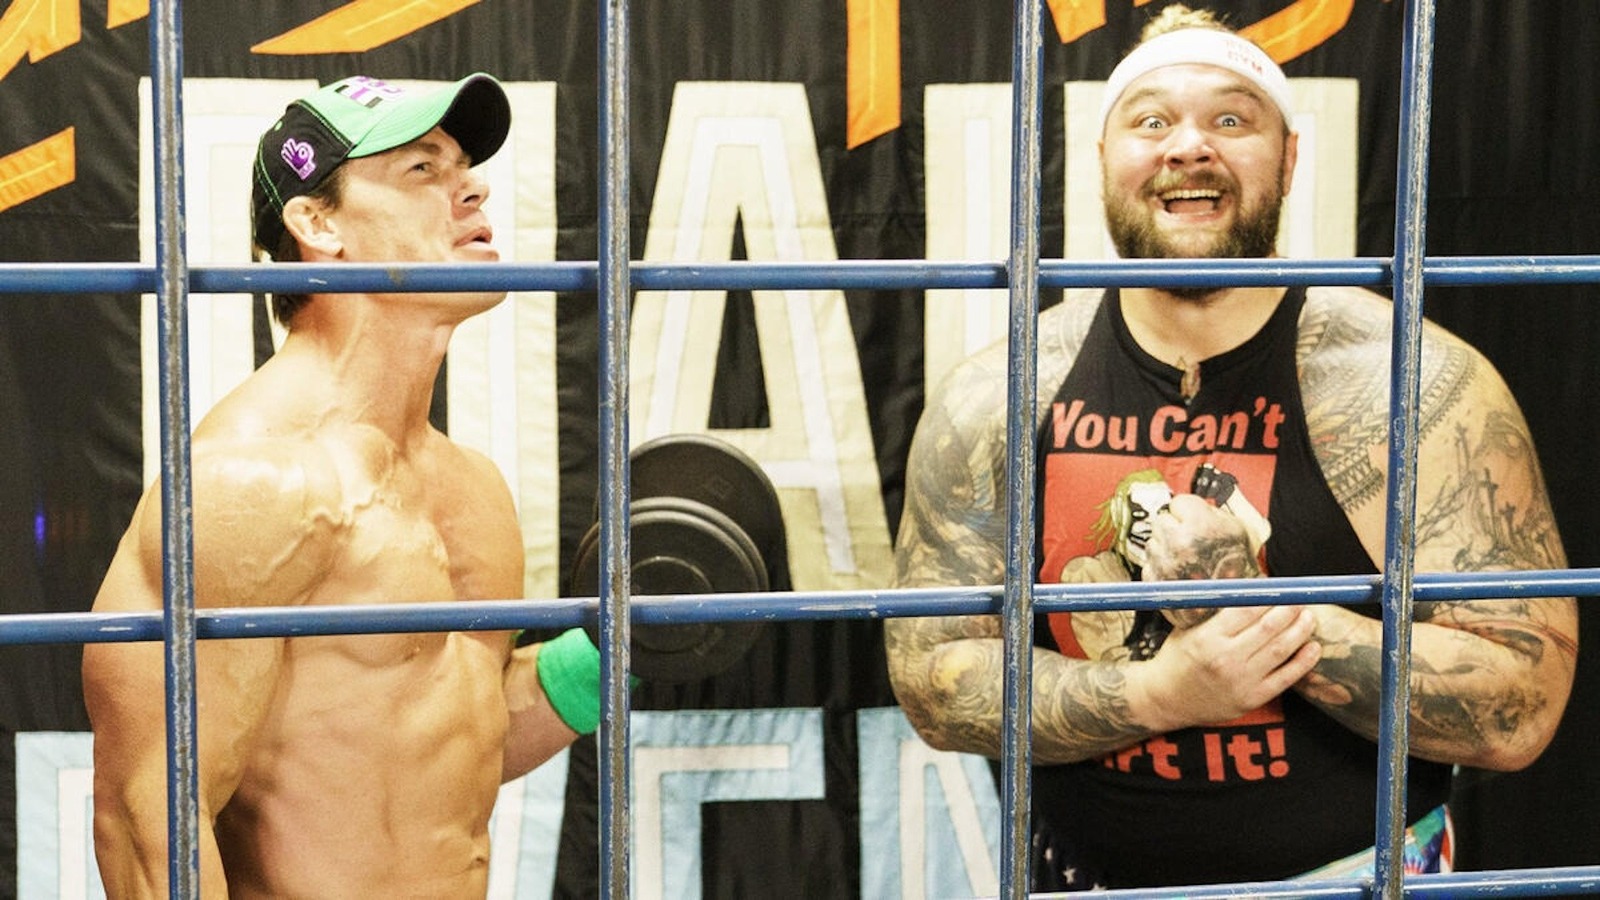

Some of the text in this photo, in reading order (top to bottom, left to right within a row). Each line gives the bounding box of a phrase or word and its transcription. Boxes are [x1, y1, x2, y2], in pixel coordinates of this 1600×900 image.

[1052, 396, 1286, 452] You Can't
[1203, 728, 1290, 782] It!
